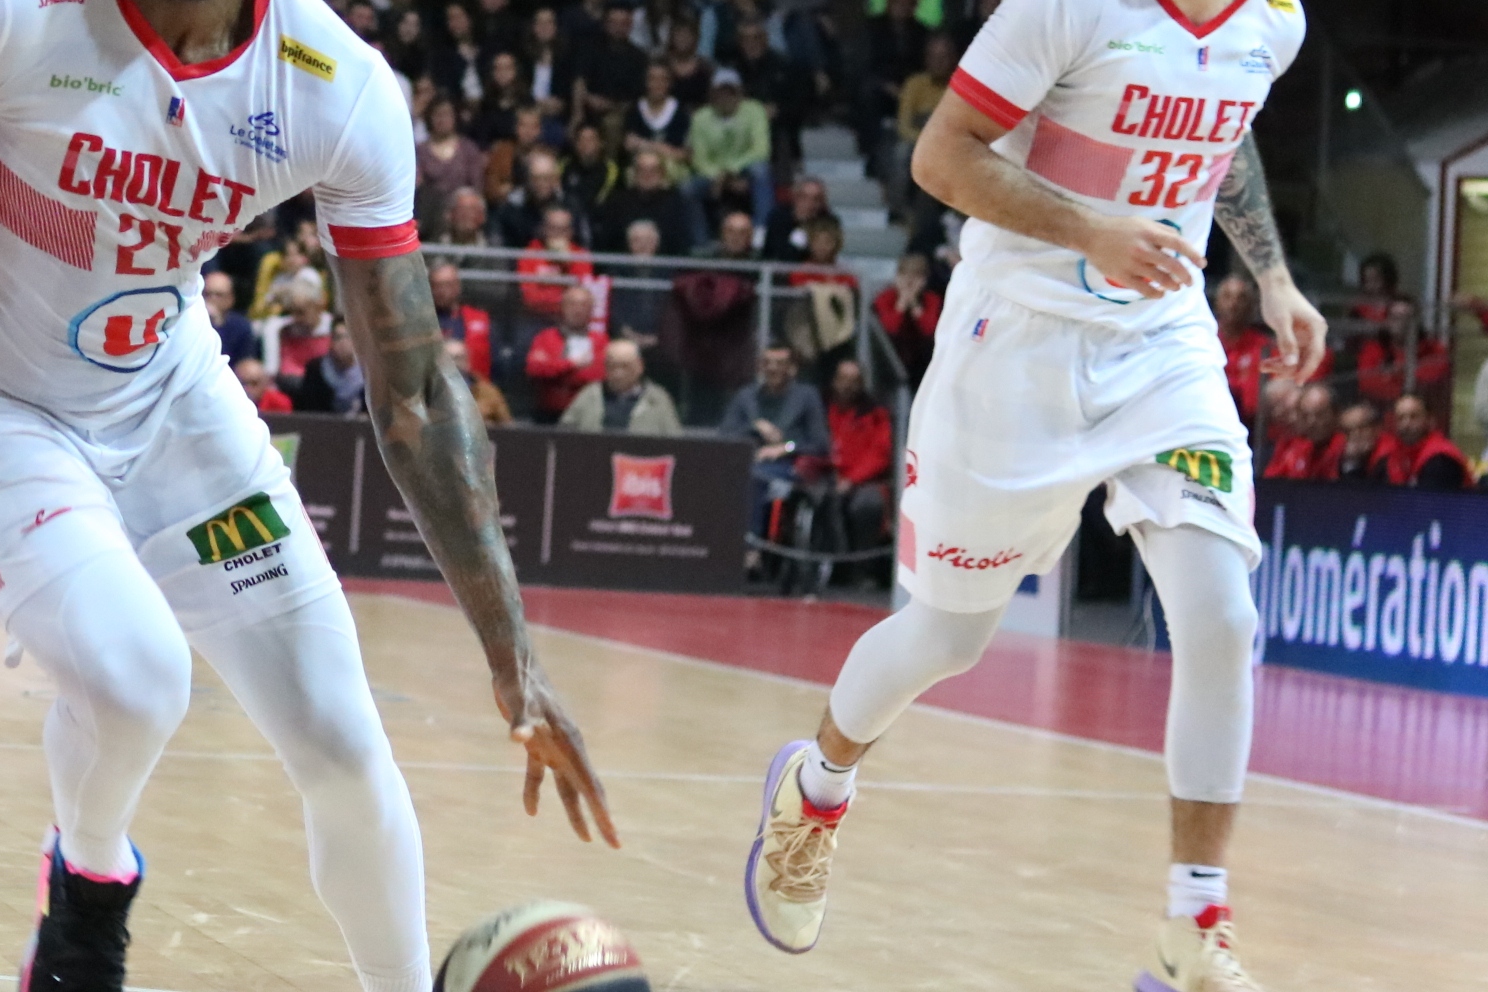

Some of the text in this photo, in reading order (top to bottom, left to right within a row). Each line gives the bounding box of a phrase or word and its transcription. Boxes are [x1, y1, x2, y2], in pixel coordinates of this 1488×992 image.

[281, 40, 333, 75] bpifrance
[49, 74, 122, 97] bio'bric
[1112, 83, 1256, 143] CHOLET
[58, 132, 256, 225] CHOLET
[1128, 150, 1205, 209] 32
[115, 213, 183, 276] 21
[223, 542, 283, 571] CHOLET
[230, 563, 289, 596] SPALDING
